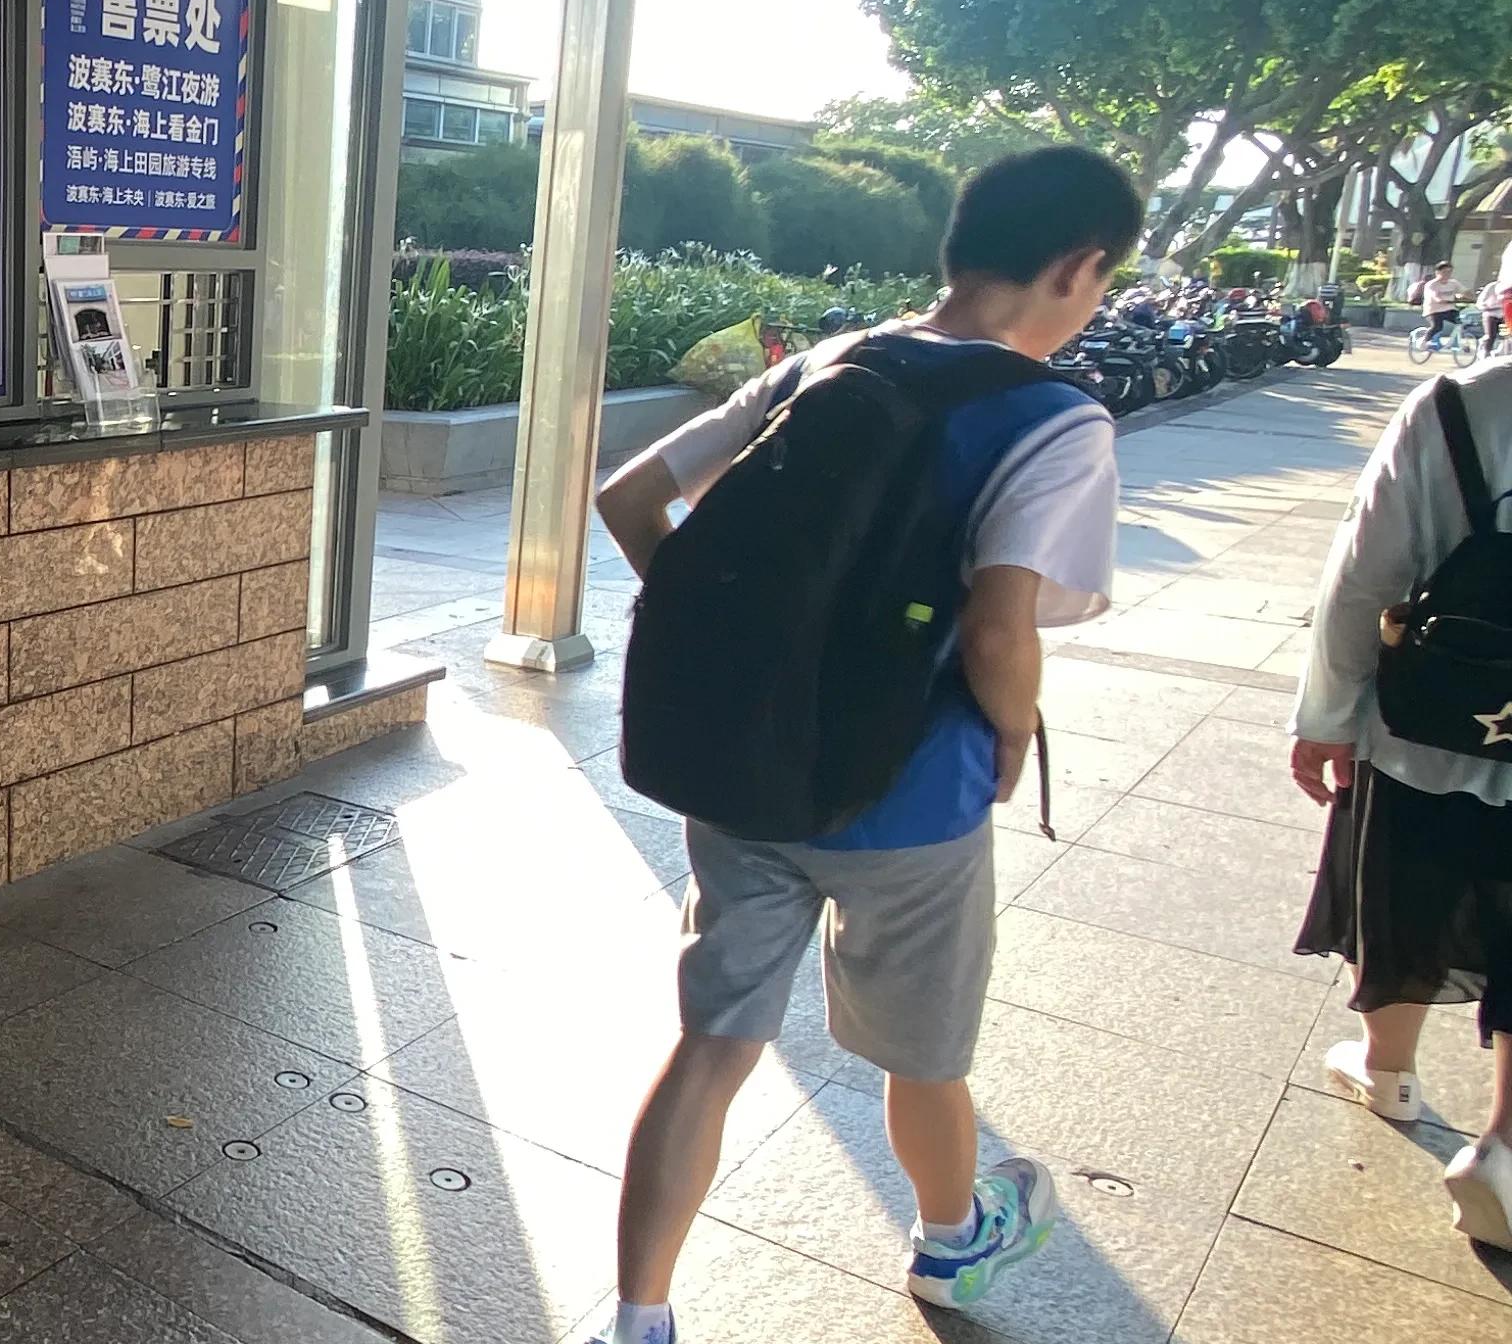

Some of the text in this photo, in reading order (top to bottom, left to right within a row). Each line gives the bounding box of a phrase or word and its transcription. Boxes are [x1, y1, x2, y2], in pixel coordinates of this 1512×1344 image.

[68, 54, 221, 107] 波赛东·鹭江夜游
[67, 102, 219, 145] 波赛东·海上看金门
